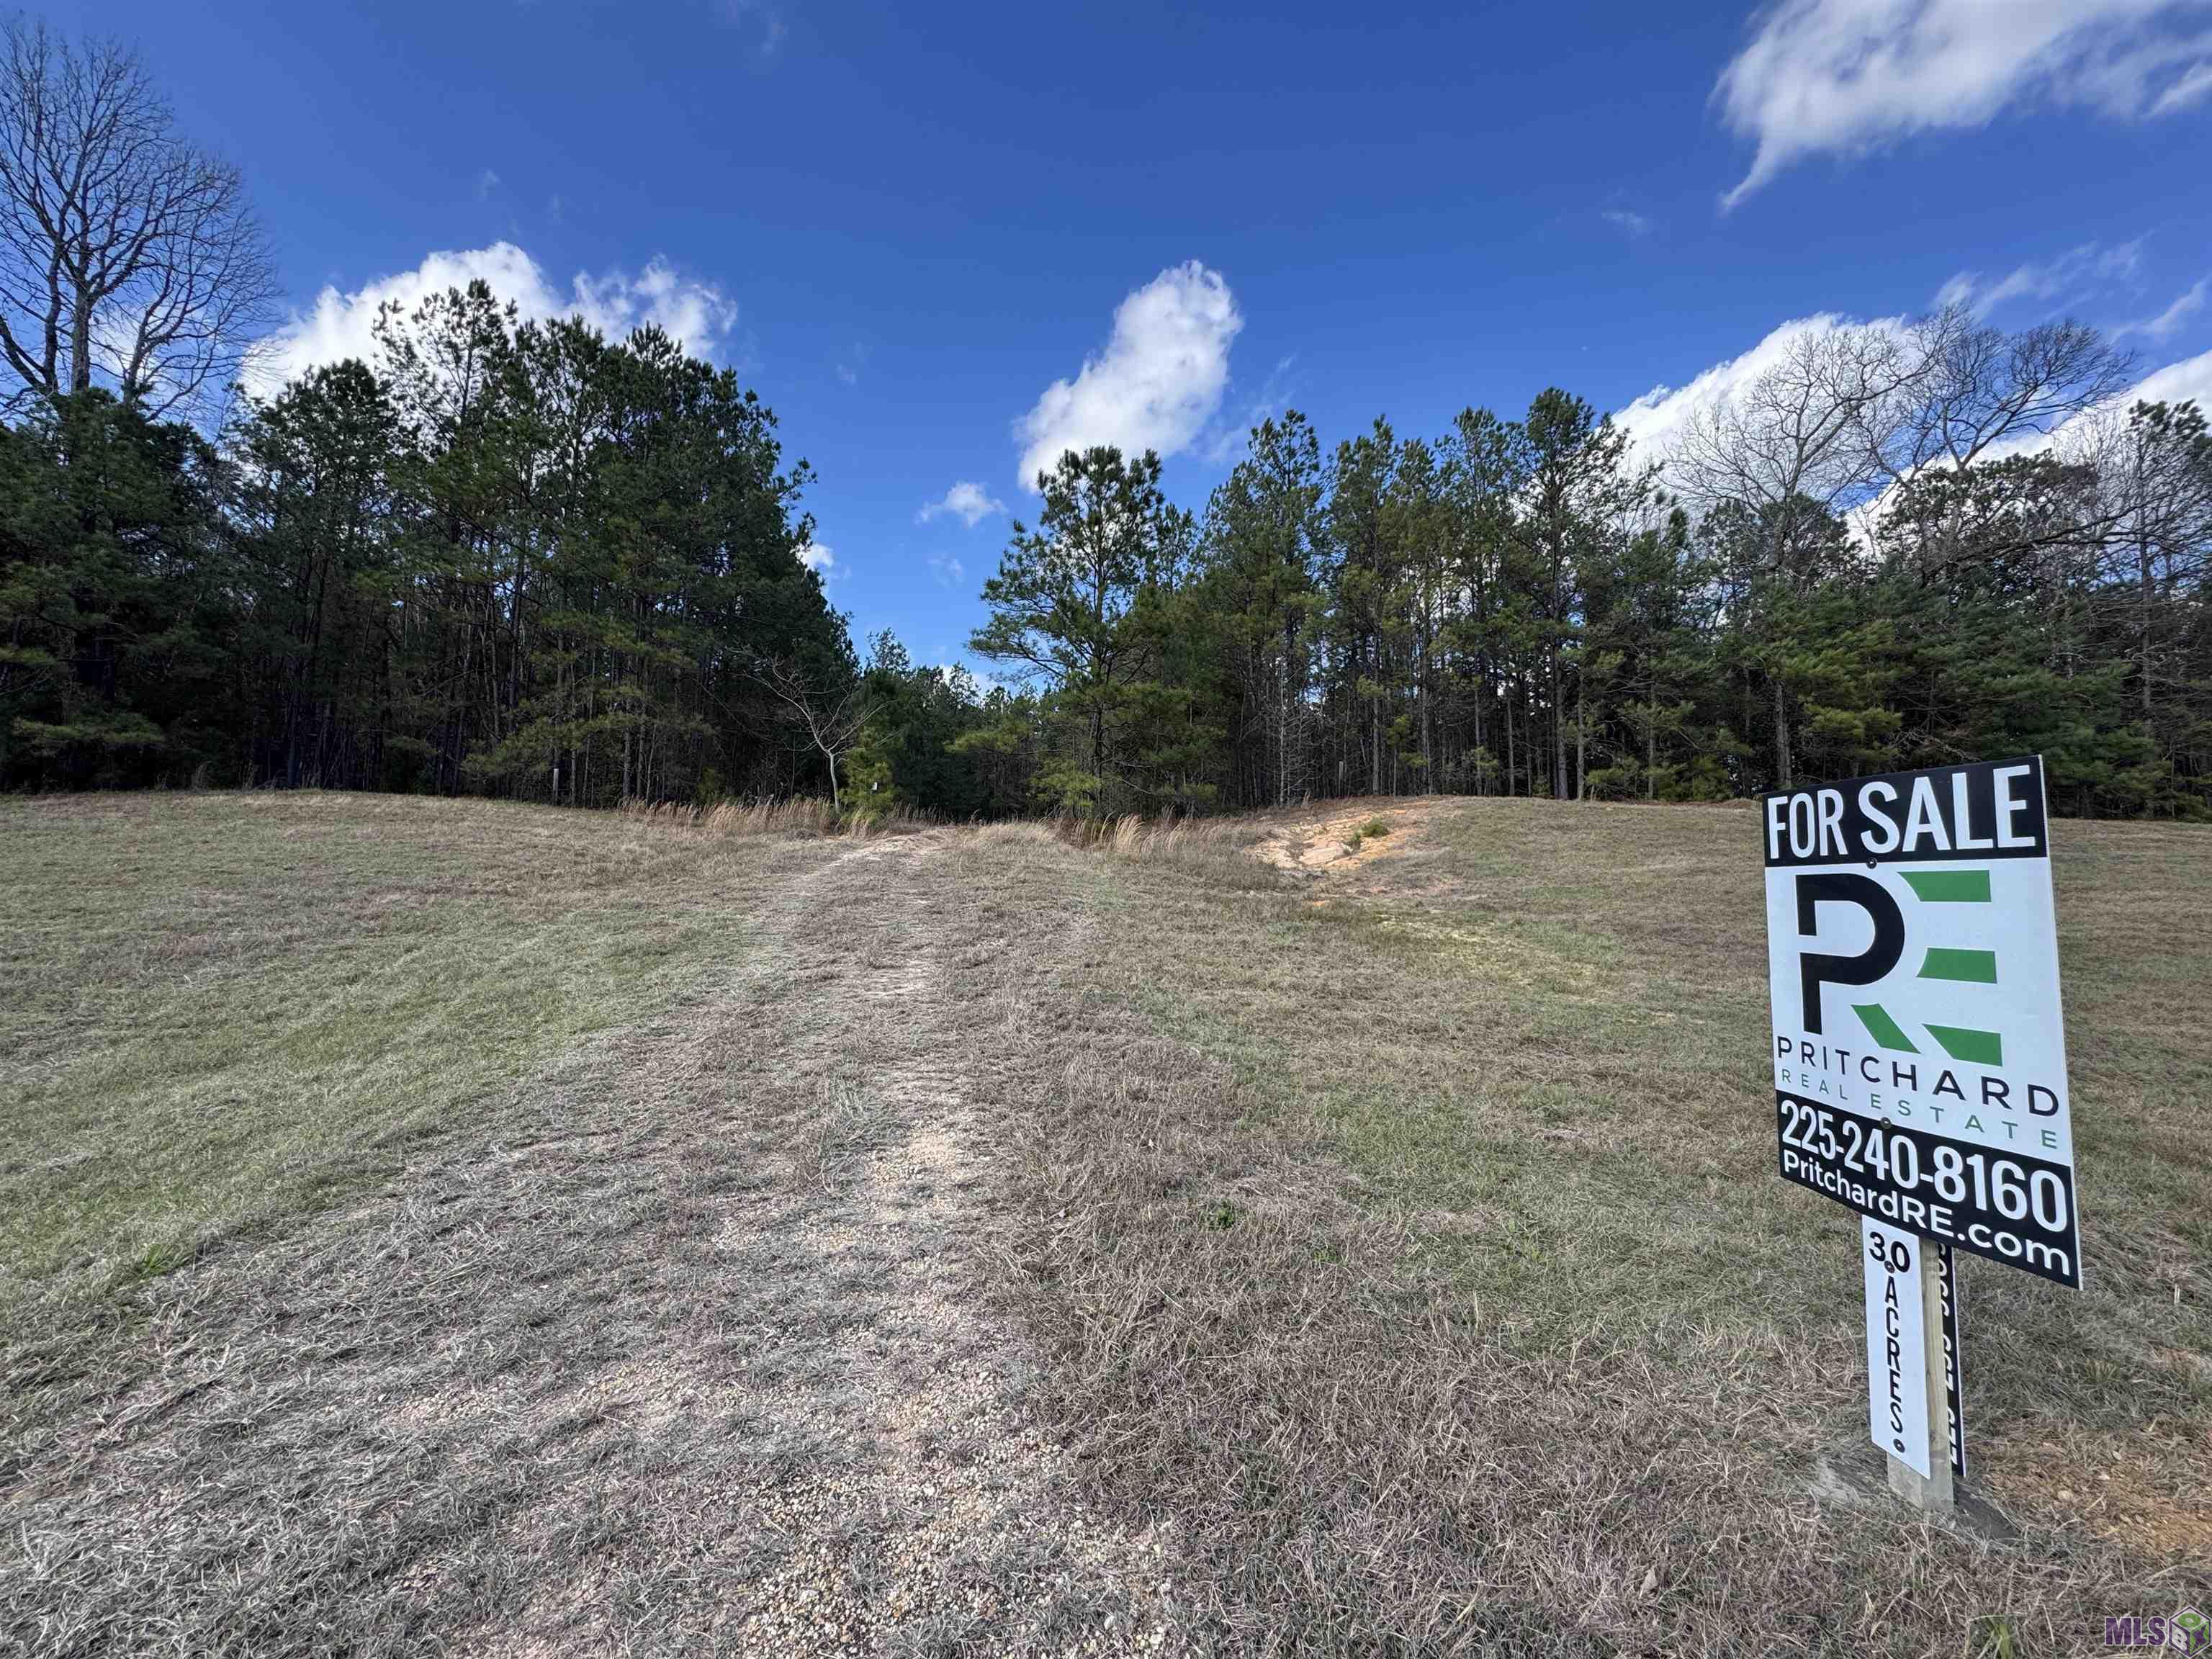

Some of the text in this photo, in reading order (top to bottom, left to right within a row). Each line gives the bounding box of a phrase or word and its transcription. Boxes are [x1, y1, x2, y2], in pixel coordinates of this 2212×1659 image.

[1768, 765, 2036, 859] FOR SALE
[1776, 1035, 2059, 1117] PRITCHARD
[1781, 1069, 2058, 1149] REAL ESTATE
[1781, 1100, 2069, 1233] 225-240-8160
[1783, 1150, 2072, 1277] PritchardRE.com
[1884, 1276, 1903, 1434] ACRES
